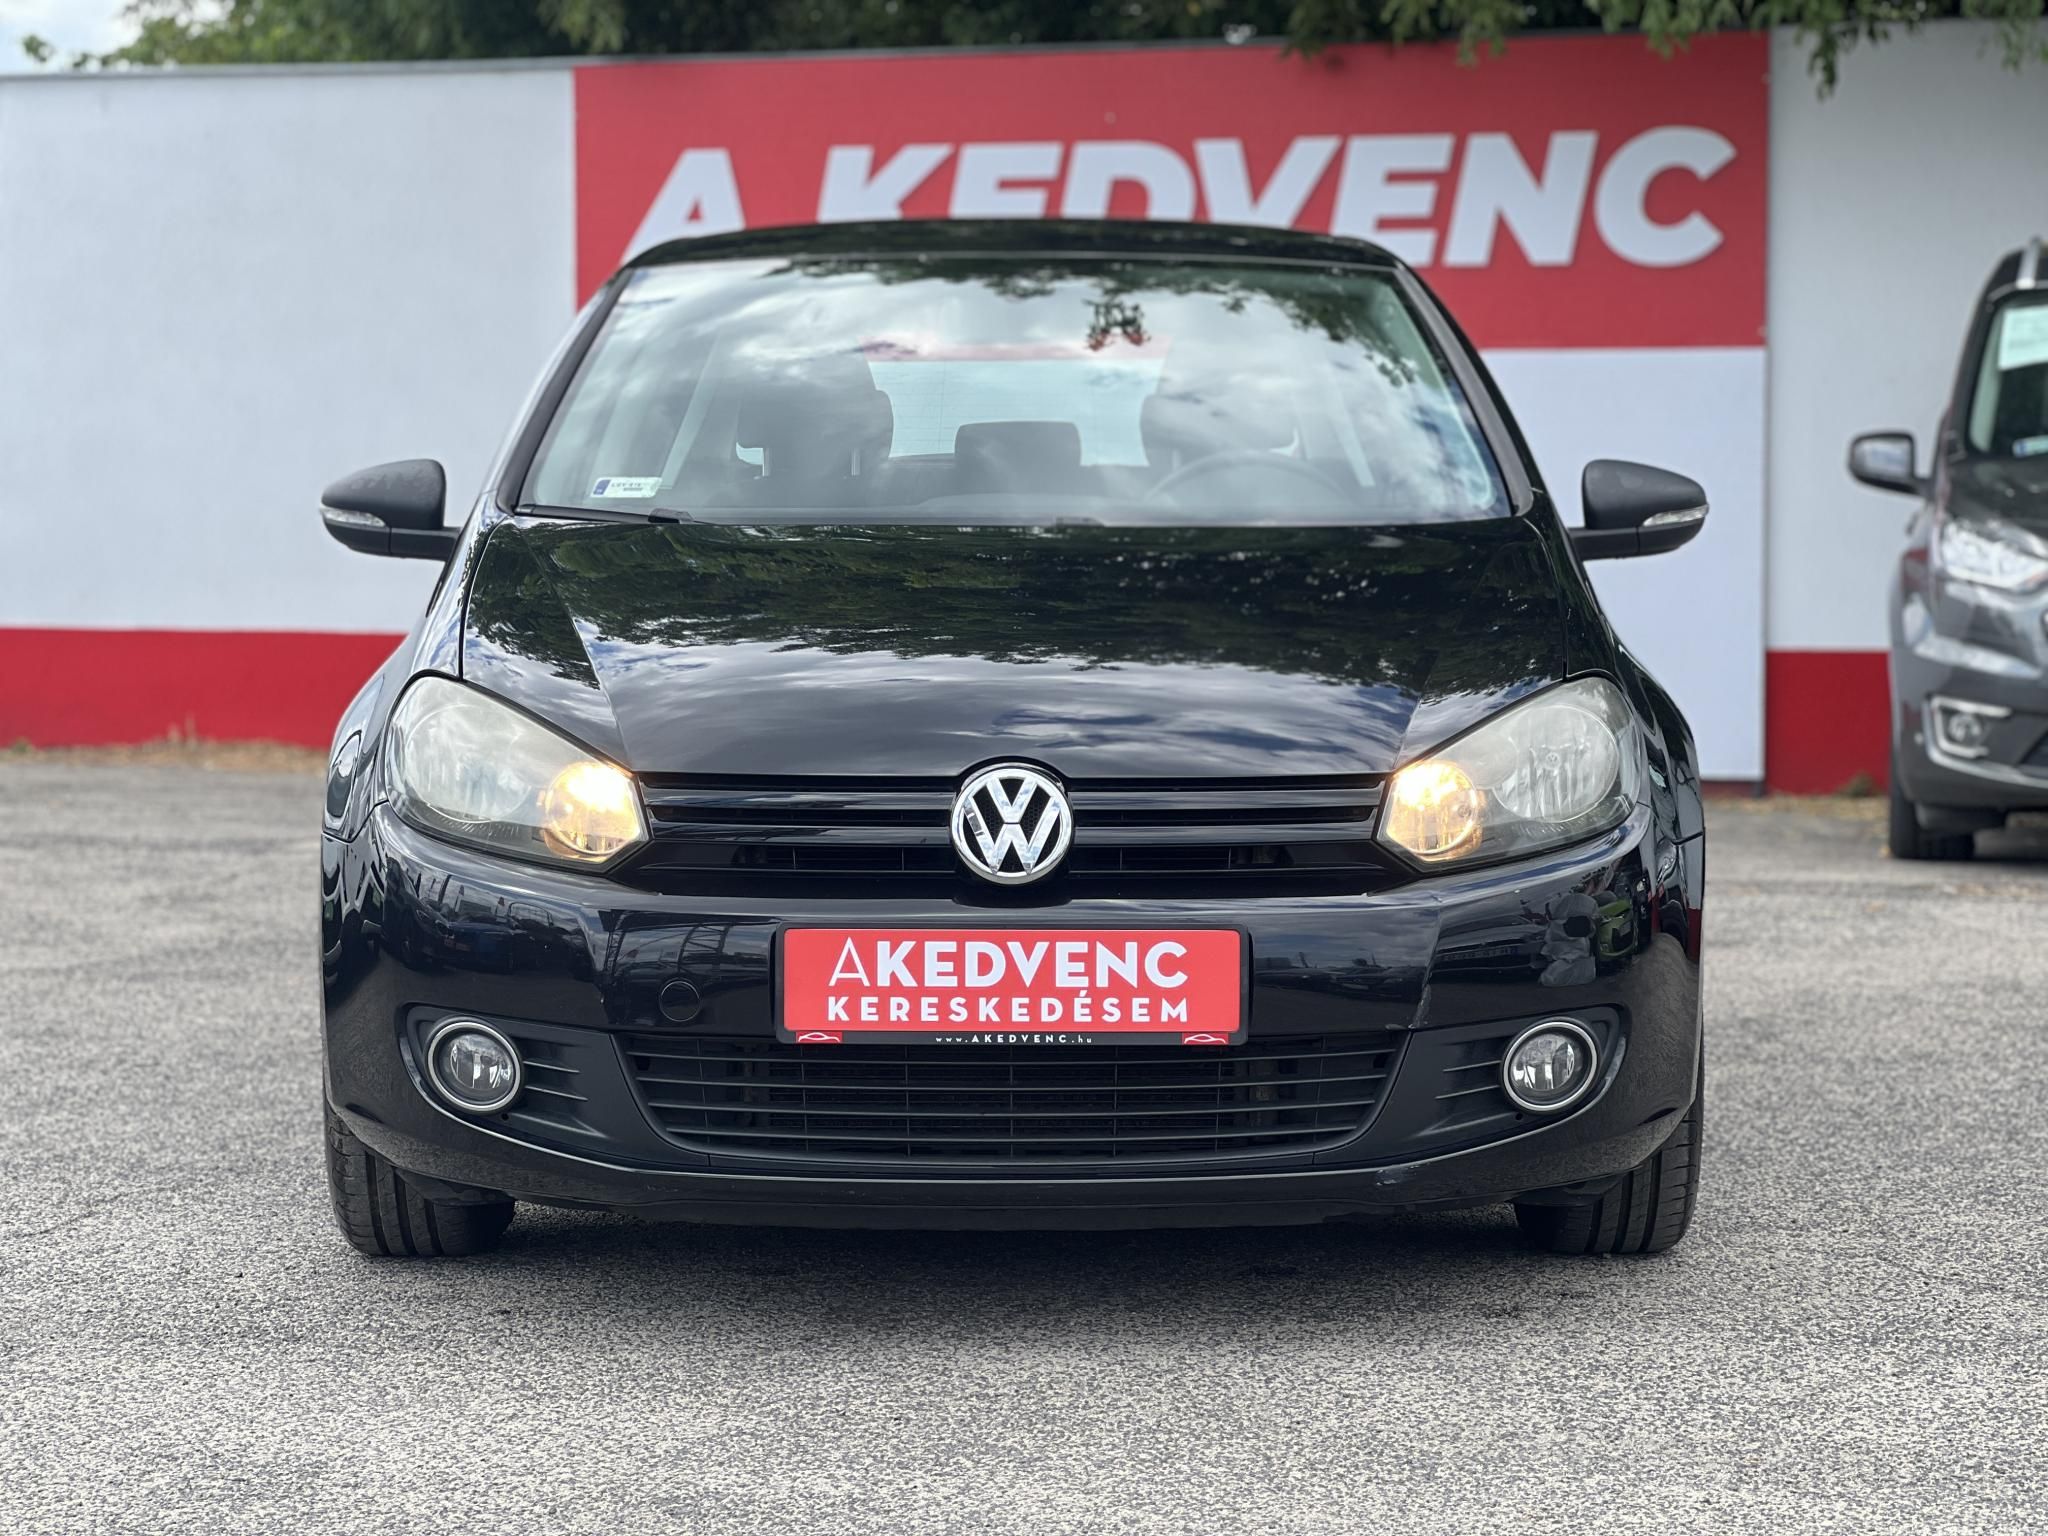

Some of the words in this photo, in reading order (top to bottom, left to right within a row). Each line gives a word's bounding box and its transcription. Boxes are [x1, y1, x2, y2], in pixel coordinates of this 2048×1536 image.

[621, 149, 746, 265] A
[816, 125, 1737, 267] KEDVENC
[957, 772, 1064, 876] VW
[828, 990, 1188, 1023] KERESKEDÉSEM
[935, 1034, 1092, 1044] www.AKEDVENC.hu
